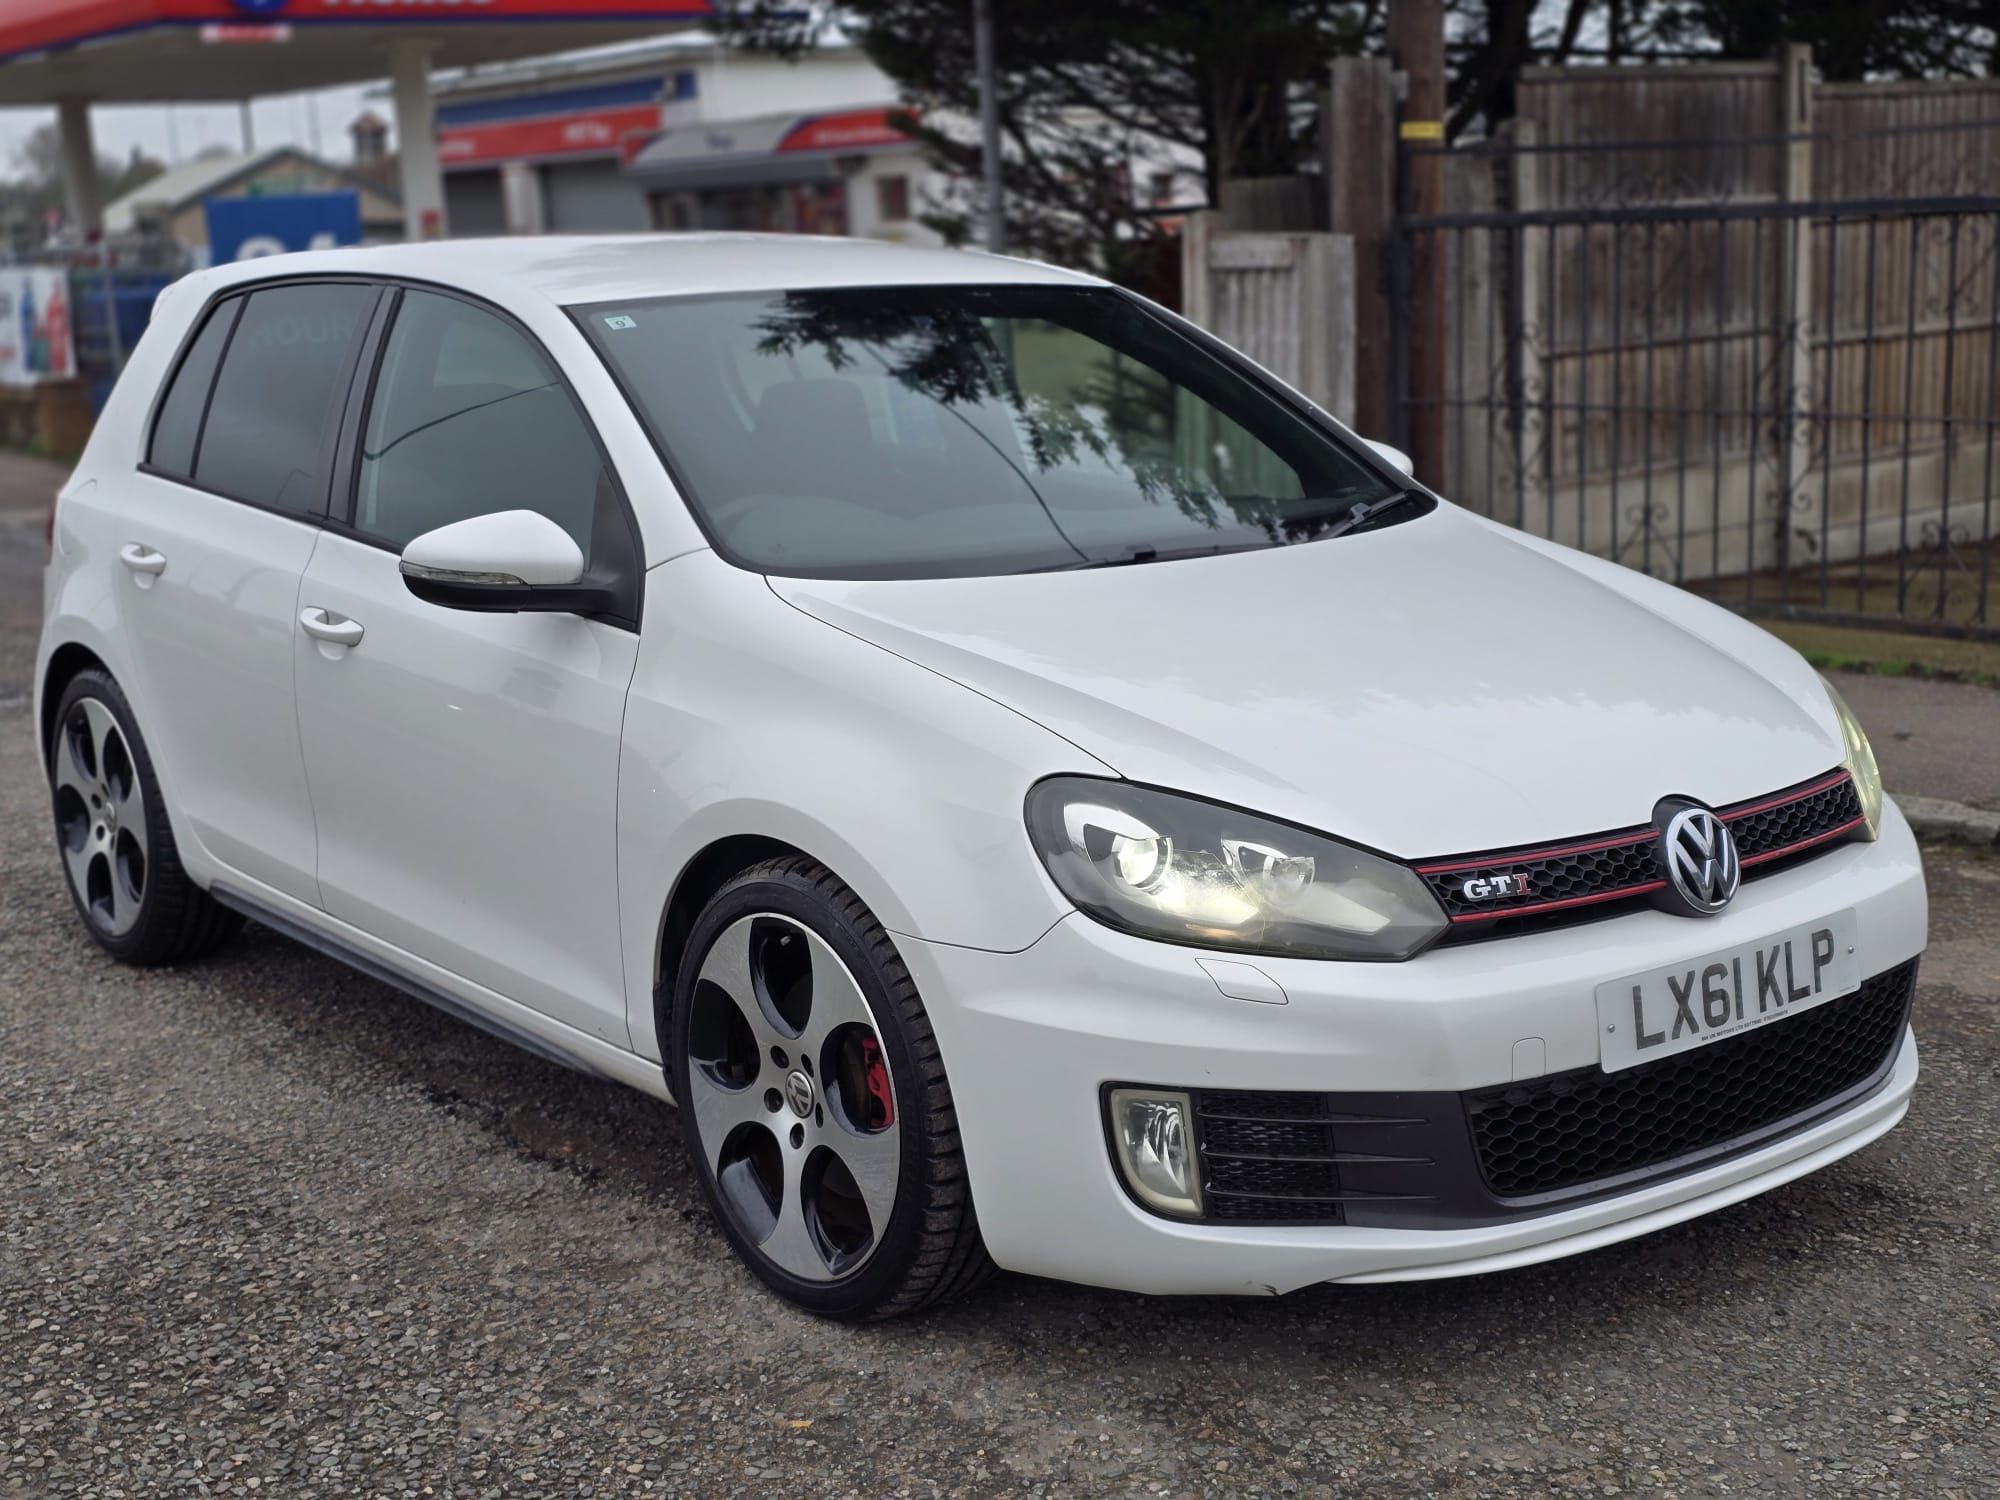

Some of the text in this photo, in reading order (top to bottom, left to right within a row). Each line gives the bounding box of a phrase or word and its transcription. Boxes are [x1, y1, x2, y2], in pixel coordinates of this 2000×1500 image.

[1463, 872, 1531, 902] GTI
[1632, 928, 1834, 1050] LX61 KLP
